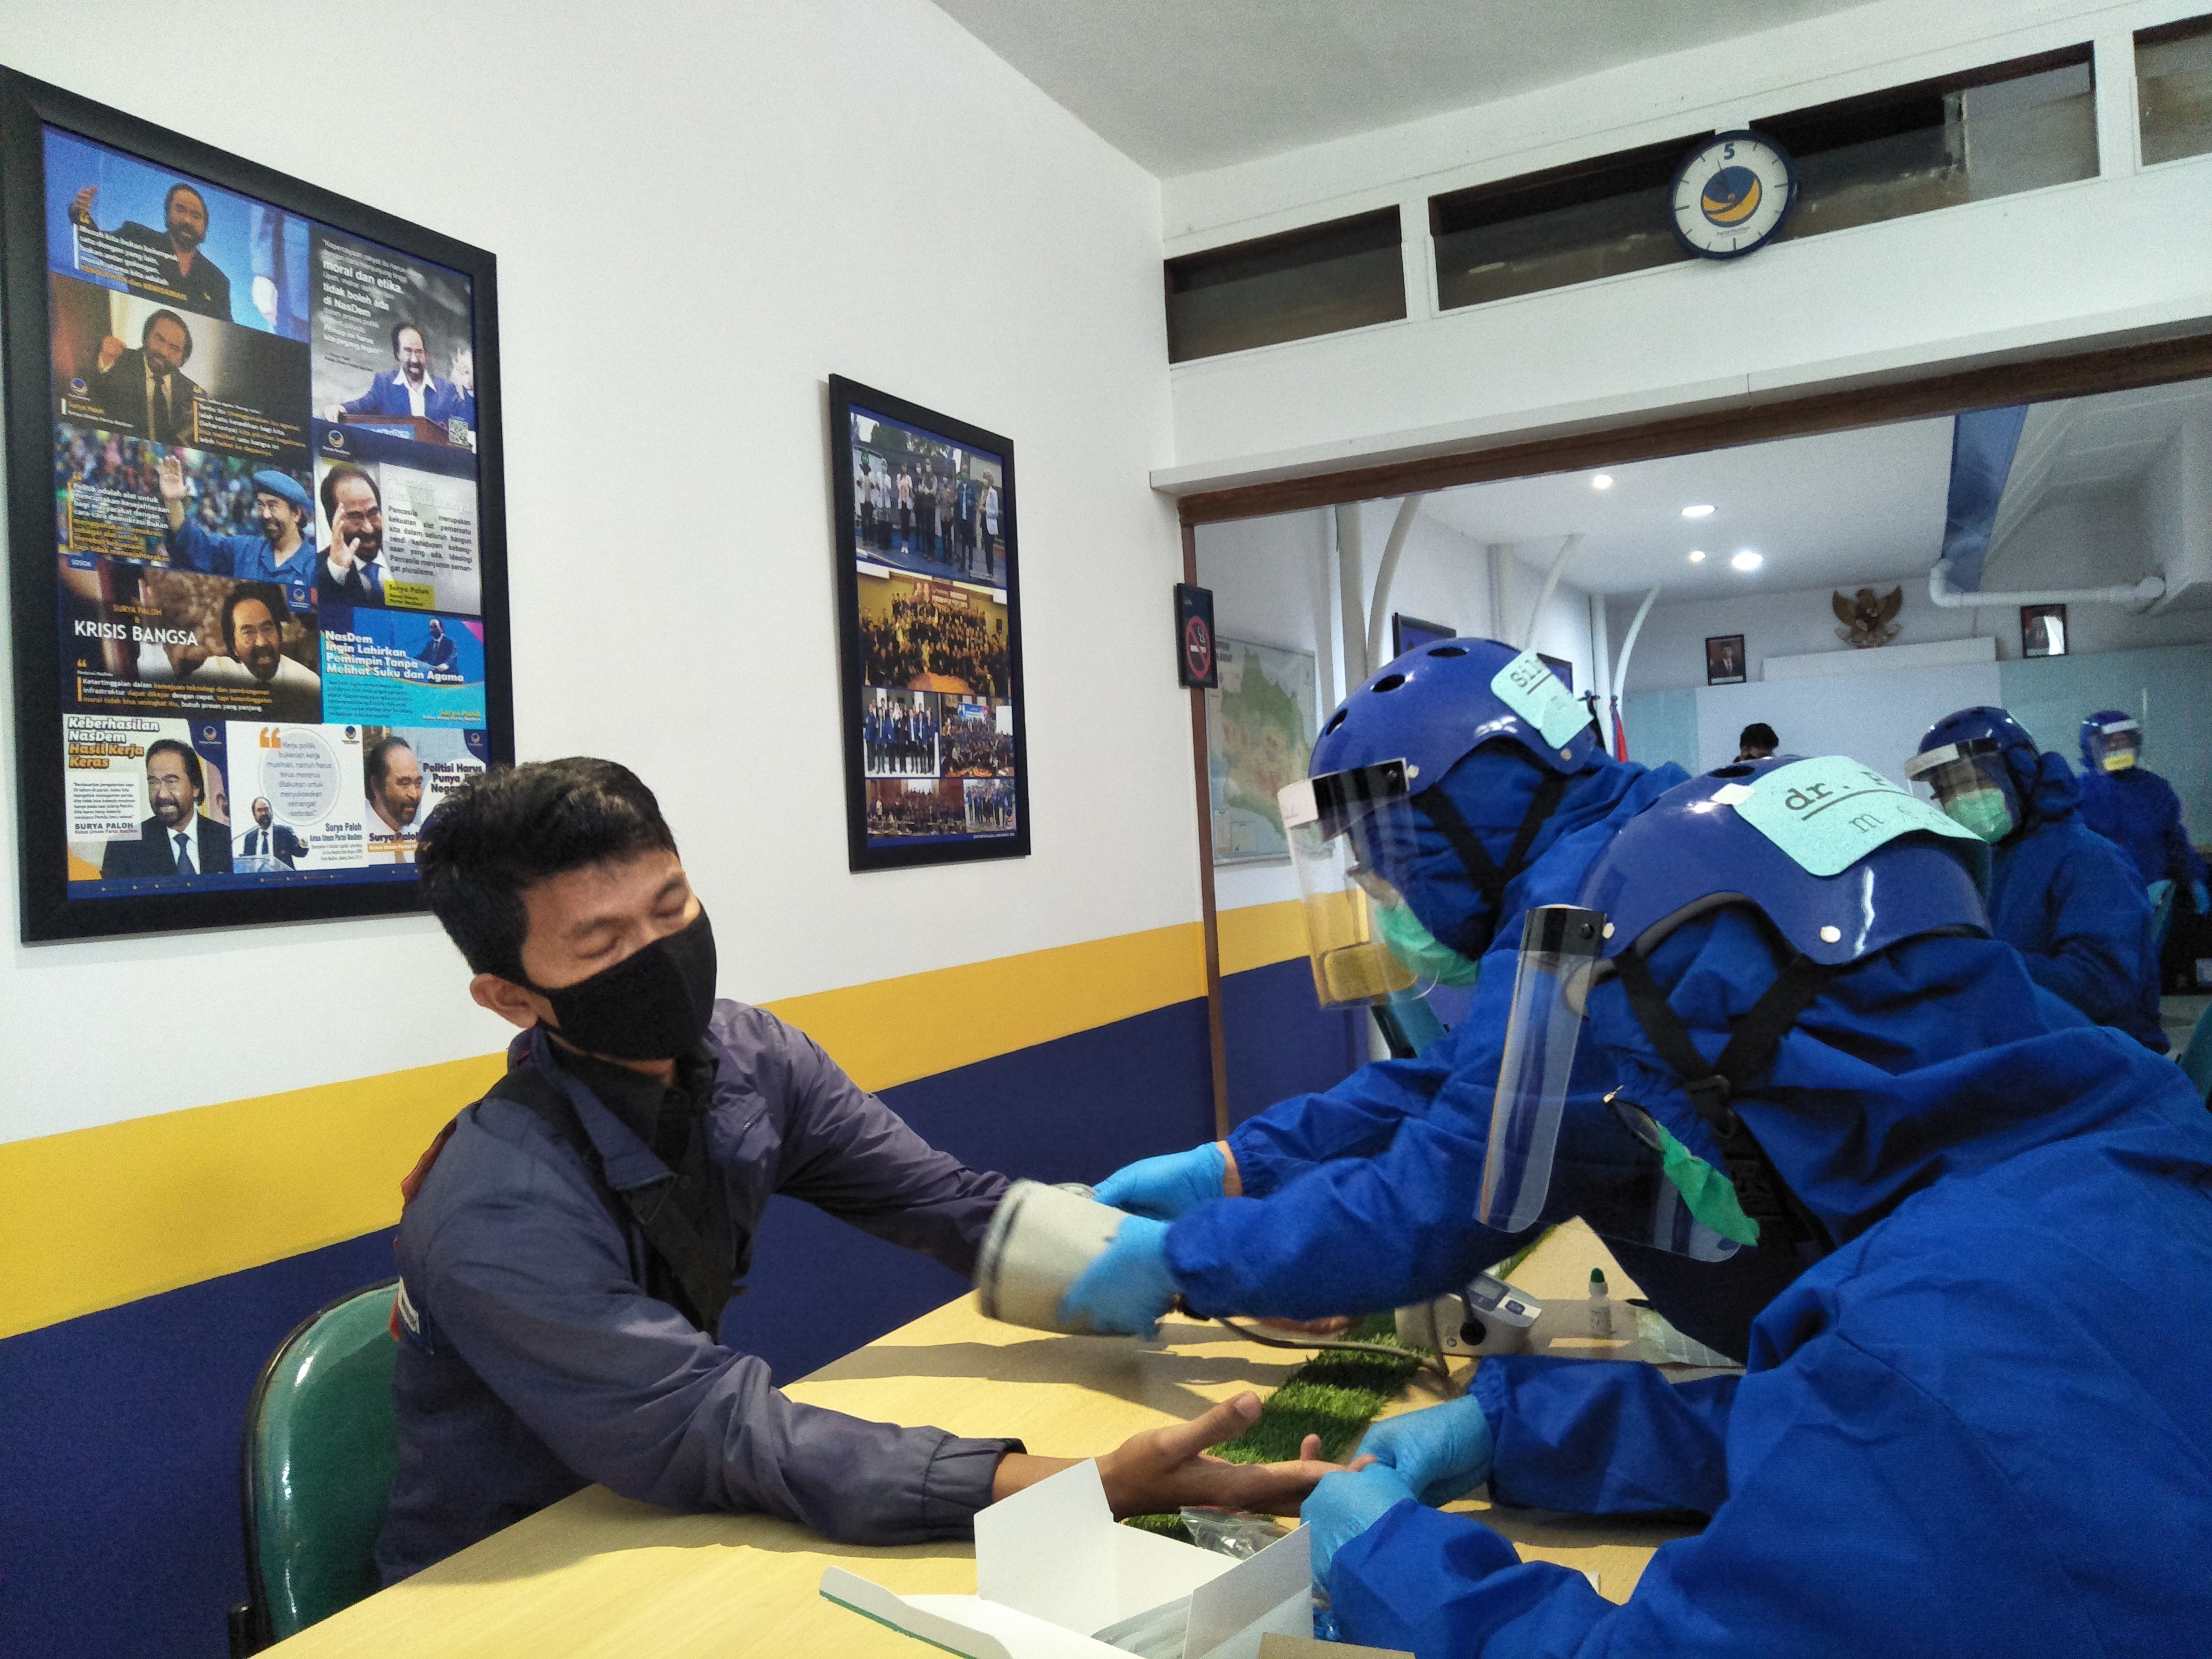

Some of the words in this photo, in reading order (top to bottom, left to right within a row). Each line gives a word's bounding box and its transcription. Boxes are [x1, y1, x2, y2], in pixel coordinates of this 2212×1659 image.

[1723, 142, 1736, 160] 5
[323, 258, 353, 278] moral
[355, 269, 374, 285] dan
[377, 276, 405, 295] etika.
[323, 282, 346, 297] tidak
[347, 289, 372, 305] boleh
[373, 298, 389, 311] ada
[323, 295, 332, 306] di
[334, 298, 371, 318] NasDem
[73, 482, 96, 492] Politik
[97, 486, 121, 497] adalah
[123, 491, 136, 499] alat
[138, 493, 158, 503] untuk
[91, 503, 132, 516] masyarakat
[133, 509, 160, 521] dengan
[108, 514, 145, 525] demokrasi
[388, 505, 417, 516] Pancasila
[439, 514, 471, 527] merupakan
[389, 515, 416, 526] kekuatan
[440, 525, 471, 536] pemersatu
[389, 524, 400, 533] kita
[404, 527, 422, 537] dalam
[450, 535, 471, 546] bangun
[389, 534, 406, 543] sendi
[412, 538, 442, 550] kehidupan
[390, 554, 419, 565] Pancasila
[421, 559, 449, 569] menjamin
[410, 549, 425, 558] yang
[449, 554, 472, 564] Ideologi
[389, 584, 408, 593] Surya
[410, 586, 429, 594] Paloh
[113, 604, 137, 614] SURYA
[137, 606, 162, 617] PALOH
[74, 619, 127, 640] KRISIS
[132, 625, 198, 647] BANGSA
[324, 630, 372, 644] NasDem
[325, 641, 354, 654] Ingin
[357, 643, 406, 658] Lahirkan
[325, 652, 382, 667] Pemimpin
[385, 657, 418, 671] Tanpa
[326, 663, 370, 676] Melihat
[372, 666, 400, 678] Suku
[403, 669, 424, 681] dan
[427, 671, 463, 684] Agama
[1510, 658, 1545, 688] Sil
[82, 677, 131, 688] Ketertinggalan
[83, 686, 125, 696] infrastruktur
[68, 716, 160, 733] Keberhasilan
[68, 730, 126, 743] NasDem
[68, 742, 106, 756] Hasil
[107, 743, 144, 759] Kerja
[69, 756, 109, 769] Keras
[423, 763, 454, 773] Politisi
[456, 763, 482, 773] Harus
[433, 774, 460, 784] Punya
[1785, 782, 1850, 811] dr.
[325, 823, 343, 833] Surya
[369, 832, 394, 843] Surya
